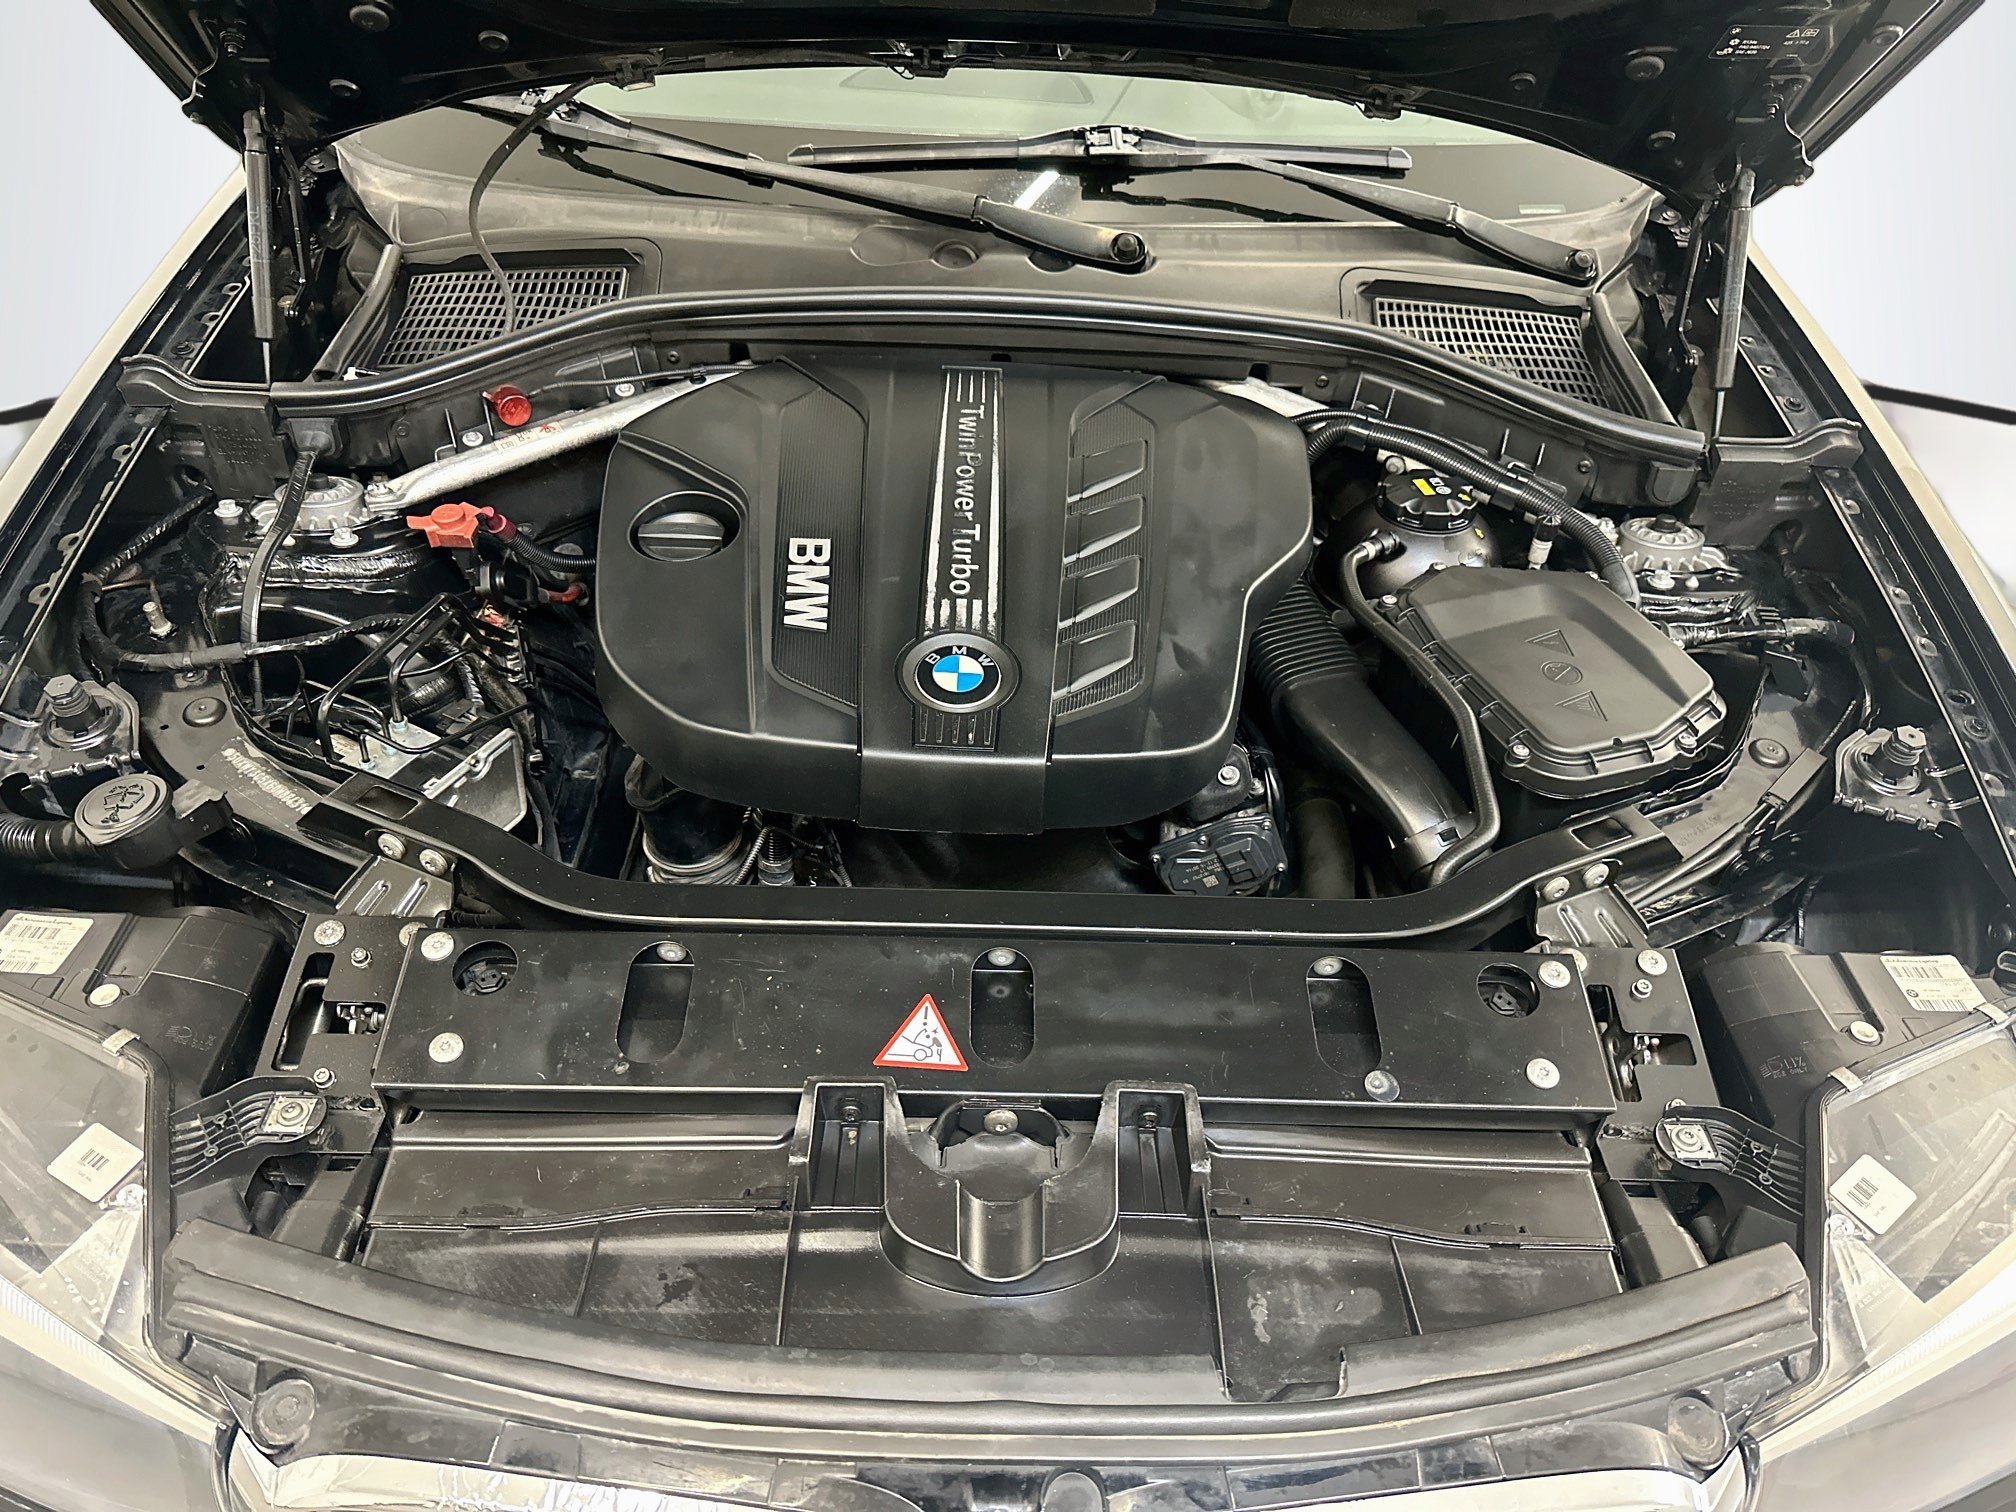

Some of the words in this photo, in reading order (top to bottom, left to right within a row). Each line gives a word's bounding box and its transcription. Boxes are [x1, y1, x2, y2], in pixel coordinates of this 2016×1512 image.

[783, 538, 831, 632] BMW
[949, 524, 981, 595] Turbo
[925, 645, 995, 666] BMW
